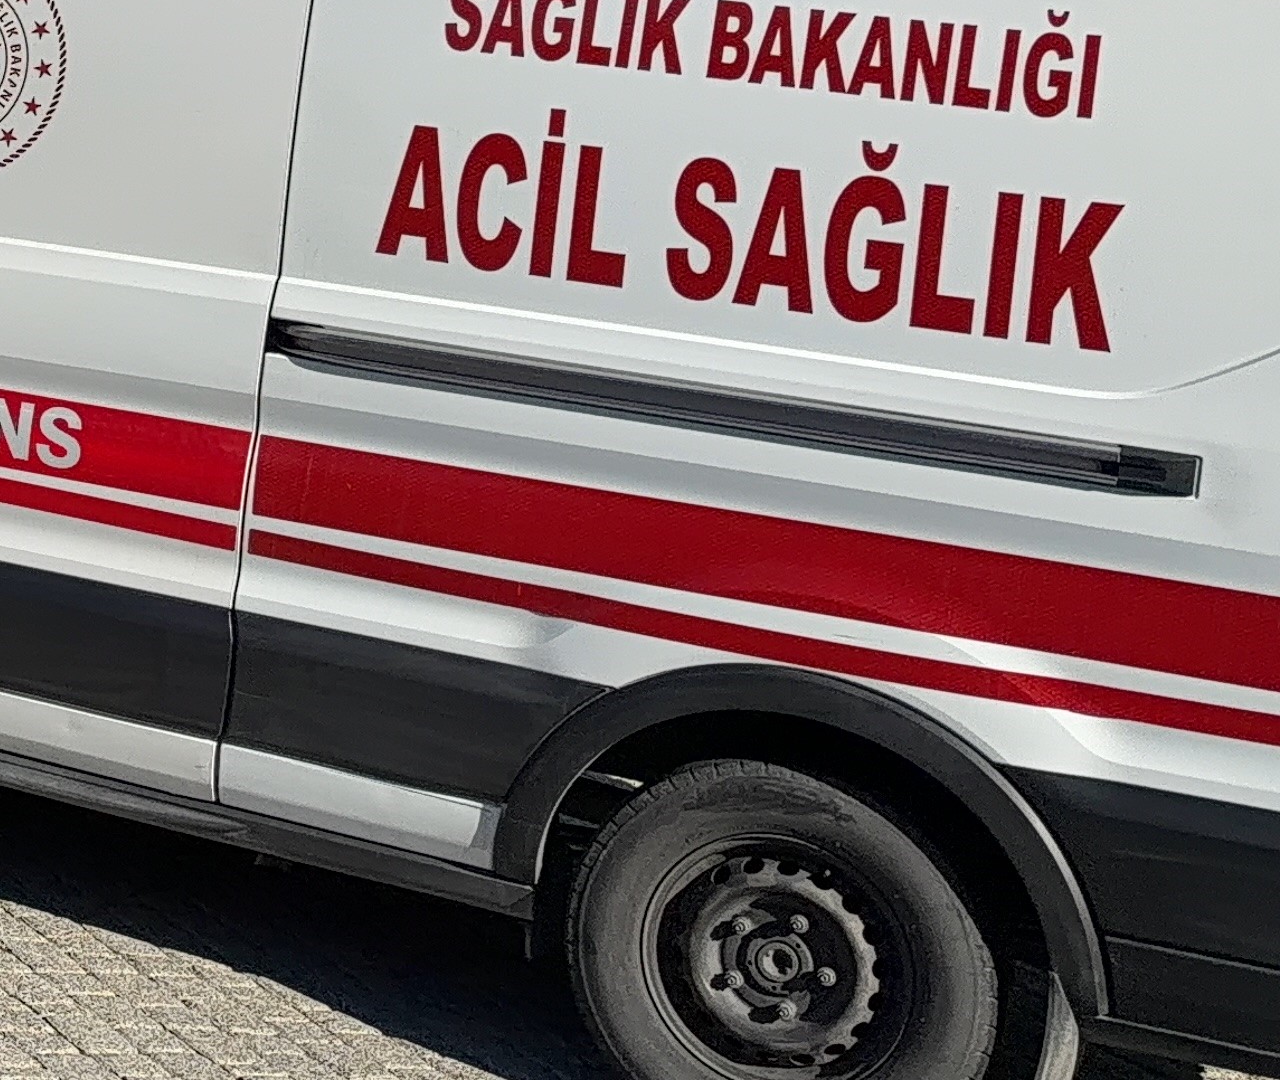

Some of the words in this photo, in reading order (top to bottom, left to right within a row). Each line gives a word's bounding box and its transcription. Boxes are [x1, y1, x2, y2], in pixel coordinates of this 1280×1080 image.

[706, 9, 1104, 119] BAKANLIĞI
[375, 108, 627, 288] ACİL
[666, 140, 1126, 353] SAĞLIK
